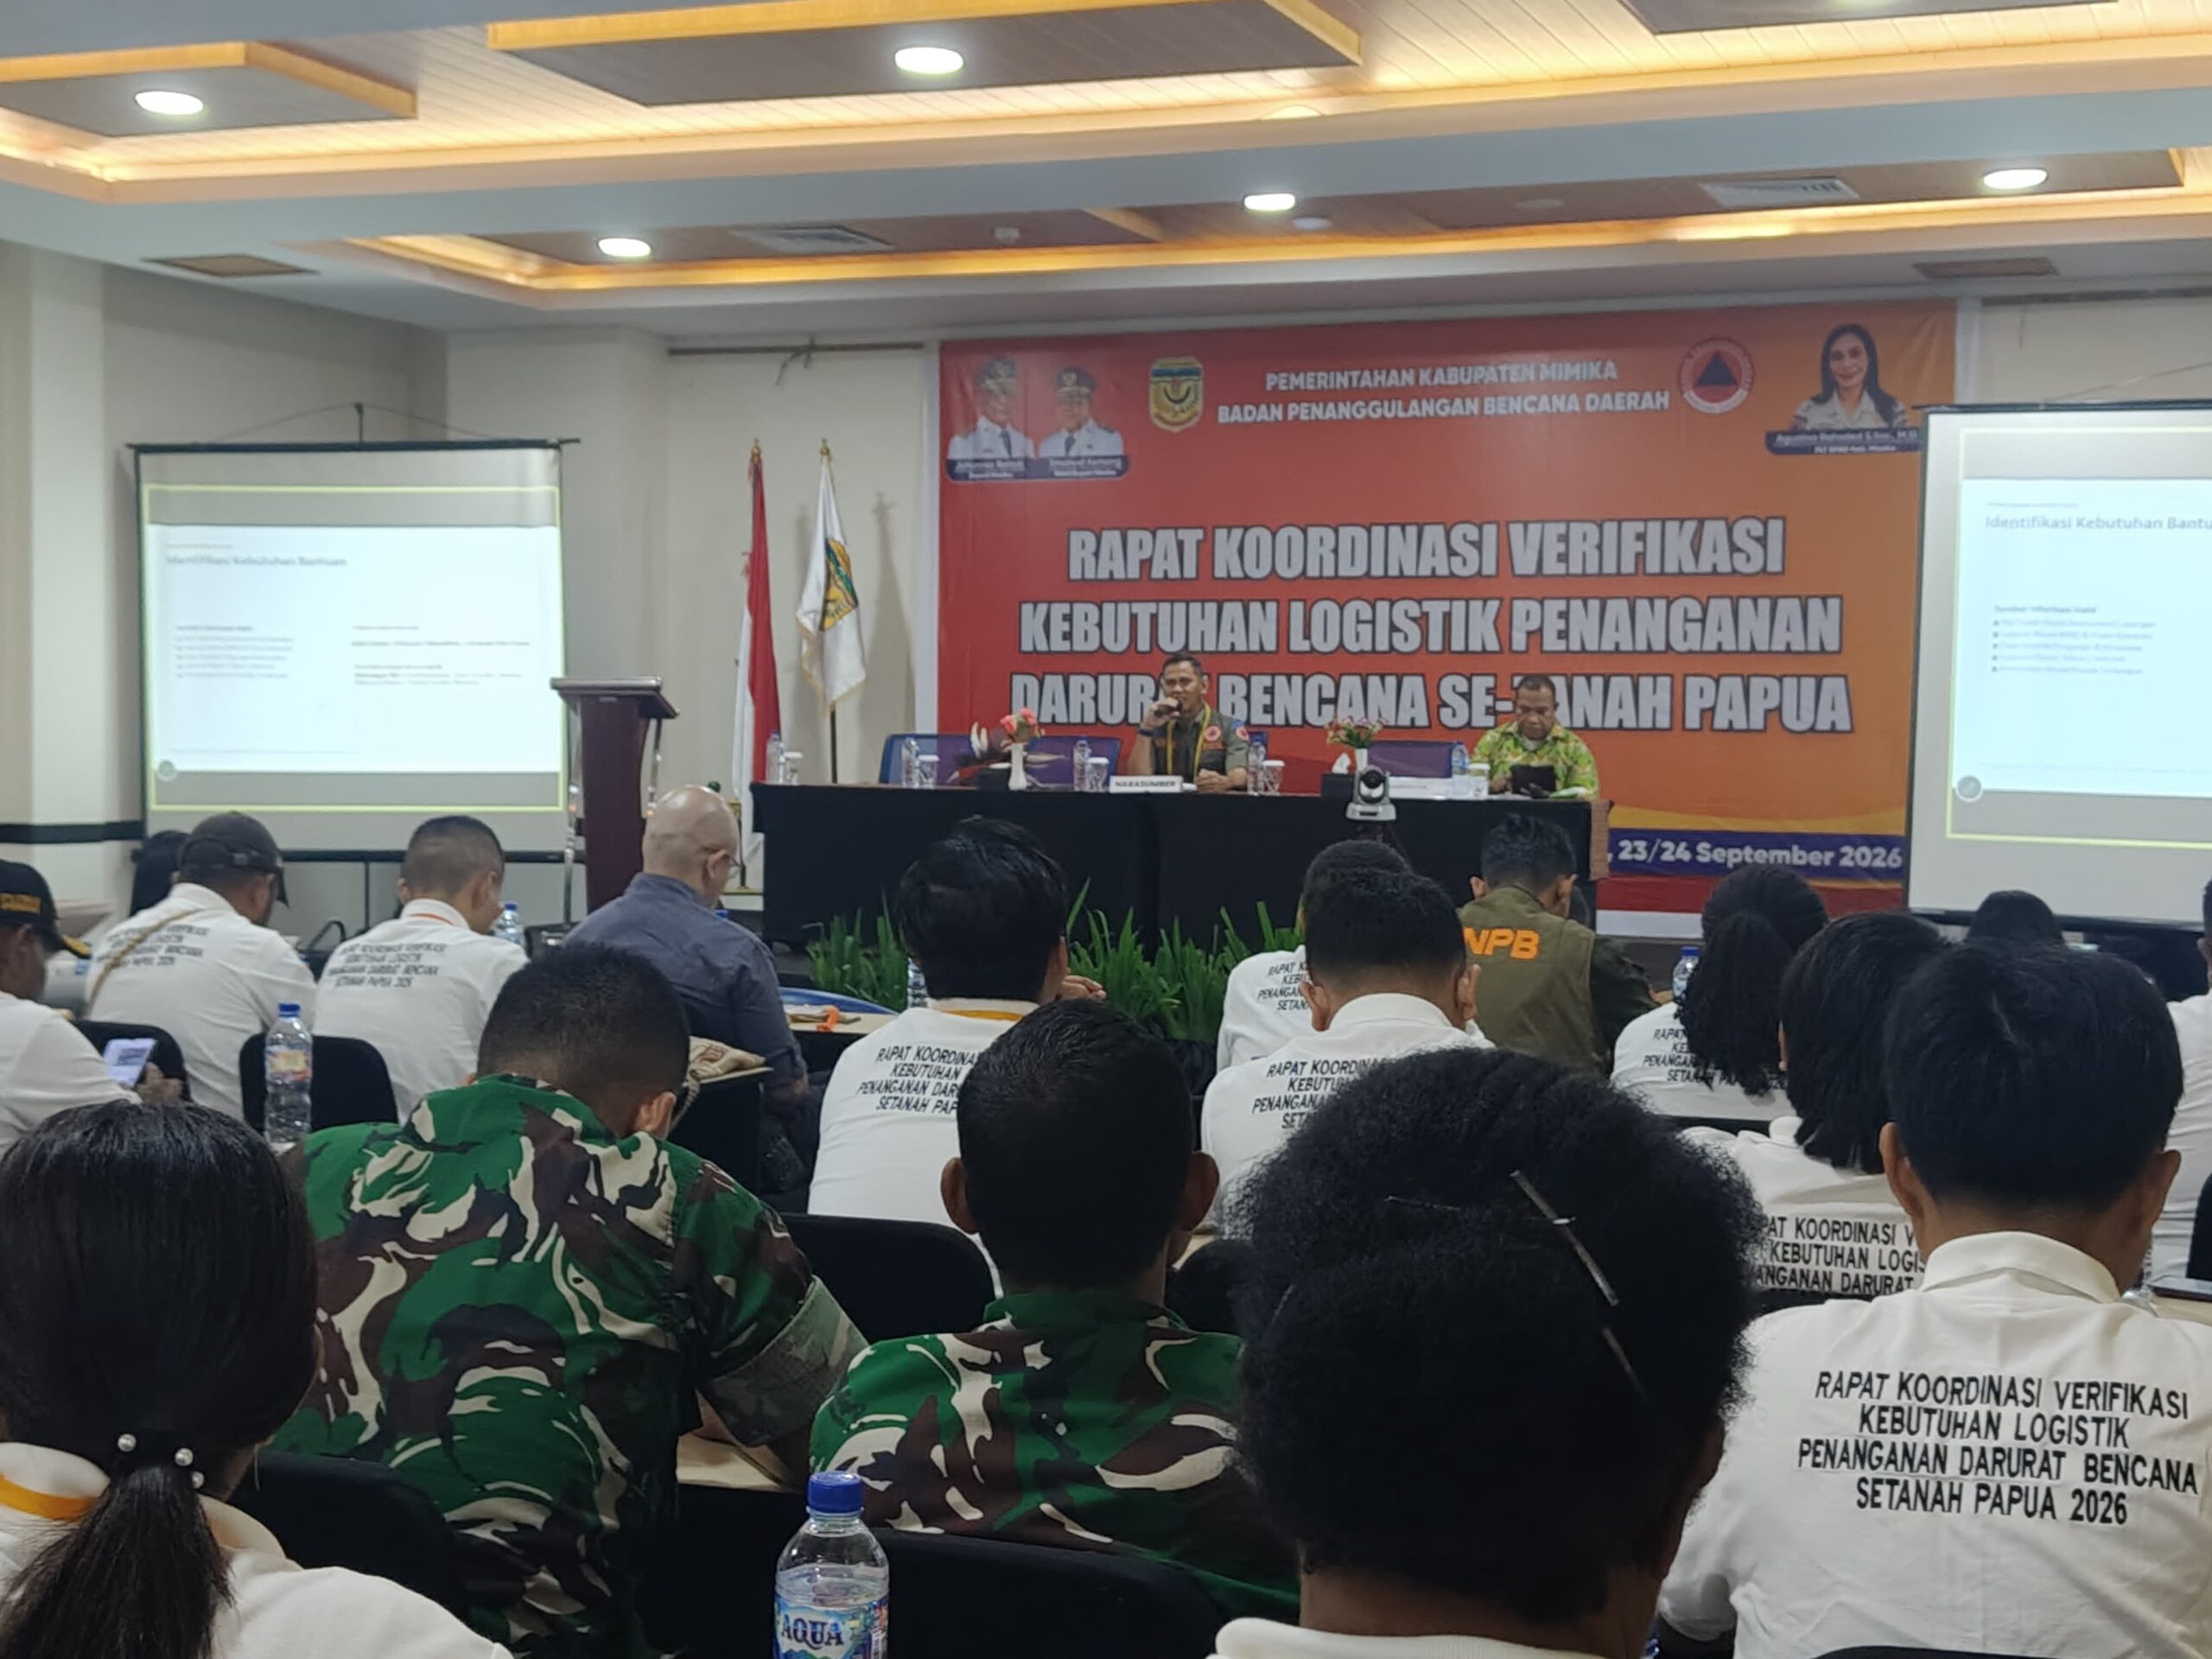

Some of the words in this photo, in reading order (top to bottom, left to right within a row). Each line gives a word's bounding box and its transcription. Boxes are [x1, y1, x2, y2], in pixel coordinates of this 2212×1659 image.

[1266, 369, 1414, 391] PEMERINTAHAN
[1420, 365, 1535, 386] KABUPATEN
[1539, 360, 1618, 381] MIMIKA
[1217, 404, 1283, 423] BADAN
[1287, 397, 1479, 421] PENANGGULANGAN
[1484, 393, 1580, 416] BENCANA
[1586, 391, 1669, 411] DAERAH
[1068, 528, 1205, 581] RAPAT
[1212, 522, 1498, 580] KOORDINASI
[1509, 517, 1786, 577] VERIFIKASI
[1019, 600, 1279, 653] KEBUTUHAN
[1288, 598, 1504, 653] LOGISTIK
[1511, 594, 1844, 654] PENANGANAN
[1011, 672, 1210, 726] DARUR
[1217, 674, 1431, 728] BENCANA
[1437, 674, 1674, 731] SE-ANAH
[1682, 674, 1853, 733] PAPUA
[1618, 838, 1693, 863] 23/24
[1696, 841, 1834, 868] September
[1839, 846, 1904, 868] 2026
[875, 1046, 912, 1063] RAPAT
[912, 1046, 979, 1065] KOORDINA
[1266, 1060, 1308, 1077] RAPAT
[890, 1063, 963, 1080] KEBUTUHAN
[856, 1079, 930, 1096] PENANGANAN
[875, 1096, 930, 1113] SETANAH
[931, 1099, 959, 1115] PAP
[1795, 1217, 1897, 1247] KOORDINASI
[1770, 1241, 1869, 1270] KEBUTUHAN
[1841, 1272, 1915, 1296] DARURAT
[1815, 1370, 1891, 1400] RAPAT
[1896, 1371, 2043, 1408] KOORDINASI
[2053, 1380, 2189, 1420] VERIFIKASI
[1859, 1404, 2002, 1440] KEBUTUHAN
[2013, 1413, 2131, 1448] LOGISTIK
[1798, 1438, 1948, 1475] PENANGANAN
[1959, 1445, 2068, 1480] DARURAT
[2083, 1452, 2199, 1495] BENCANA
[1856, 1477, 1964, 1514] SETANAH
[1974, 1482, 2057, 1520] PAPUA
[2069, 1489, 2128, 1525] 2026
[780, 1614, 845, 1650] AQUA
